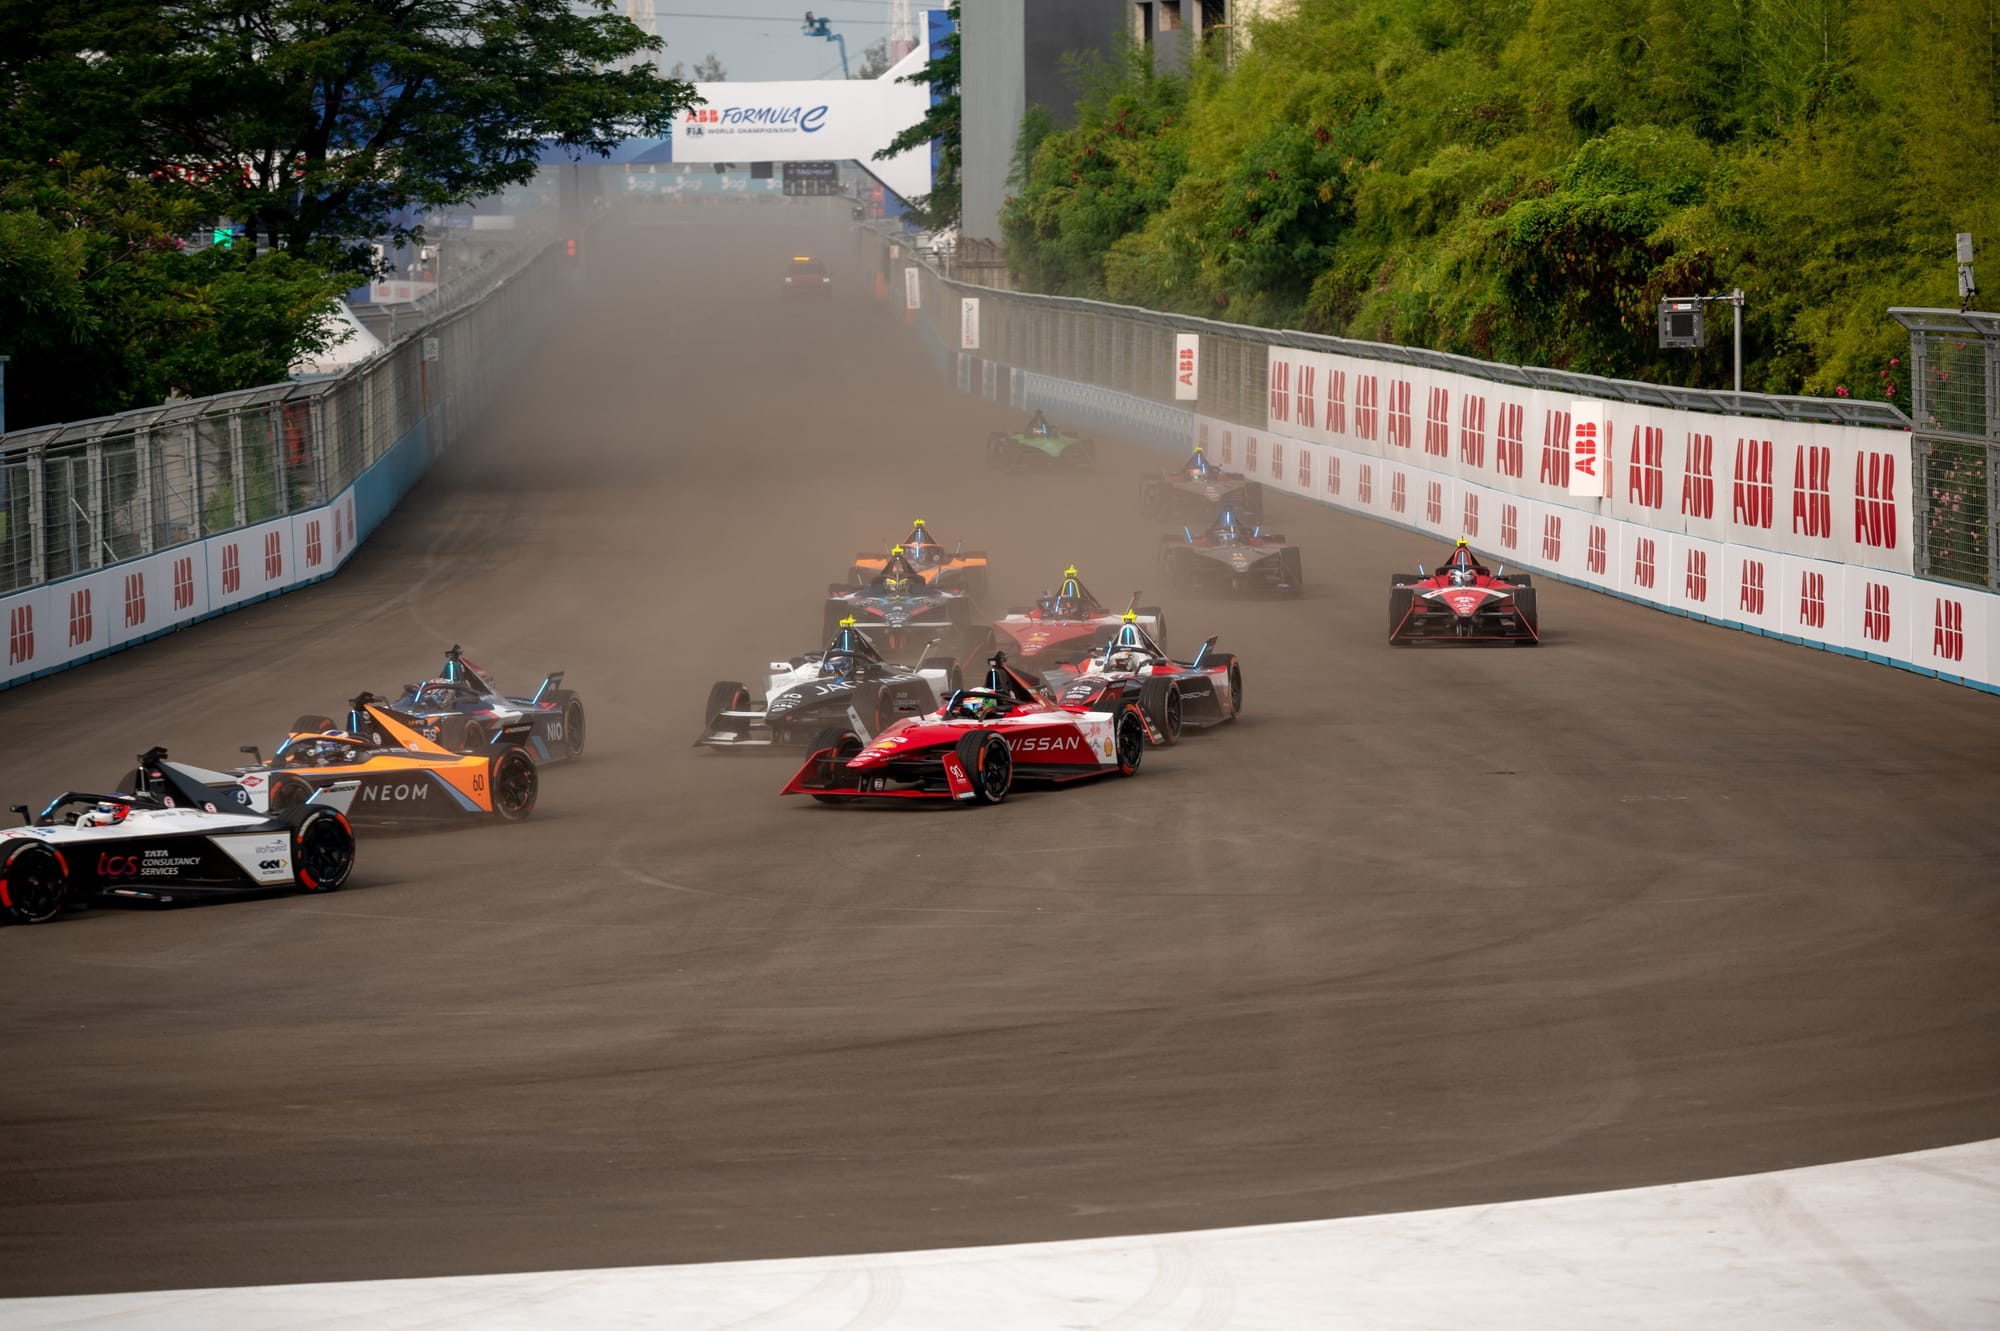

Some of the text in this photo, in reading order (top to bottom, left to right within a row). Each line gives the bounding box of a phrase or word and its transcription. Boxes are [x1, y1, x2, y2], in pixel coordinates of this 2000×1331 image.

[686, 109, 719, 123] ABB
[721, 107, 801, 124] FORMULA
[1179, 348, 1194, 386] ABB
[1271, 361, 1289, 421] ABB
[1297, 365, 1315, 428] ABB
[1326, 369, 1346, 434] ABB
[1355, 375, 1378, 441] ABB
[1388, 379, 1412, 449] ABB
[1424, 386, 1449, 458] ABB
[1461, 393, 1486, 469] ABB
[1496, 402, 1524, 479] ABB
[1575, 422, 1597, 477] ABB
[1300, 450, 1311, 488] ABB
[1328, 456, 1341, 495] ABB
[1358, 464, 1371, 504] ABB
[1391, 472, 1406, 513] ABB
[1629, 424, 1665, 510] ABB
[1681, 432, 1714, 520] ABB
[1733, 438, 1774, 529] ABB
[1793, 445, 1832, 539] ABB
[1427, 480, 1442, 525] ABB
[1463, 491, 1479, 537] ABB
[1501, 503, 1517, 550] ABB
[1854, 451, 1898, 550] ABB
[265, 531, 282, 582] ABB
[306, 519, 321, 569] ABB
[1543, 514, 1562, 562] ABB
[1587, 525, 1607, 575] ABB
[1634, 537, 1655, 590] ABB
[174, 557, 194, 612] ABB
[222, 543, 241, 596] ABB
[1685, 549, 1708, 603] ABB
[1741, 559, 1765, 616] ABB
[69, 589, 93, 649] ABB
[125, 573, 146, 629] ABB
[1800, 571, 1826, 629] ABB
[1864, 583, 1891, 643] ABB
[10, 605, 35, 666] ABB
[1933, 598, 1963, 662] ABB
[547, 722, 563, 741] NIO
[1006, 736, 1080, 752] NISSAN
[236, 790, 247, 804] 9
[362, 784, 429, 801] NEOM
[472, 774, 484, 791] 60
[97, 851, 138, 876] tcs
[140, 866, 179, 876] SERVICES
[142, 857, 201, 867] CONSULTANCY
